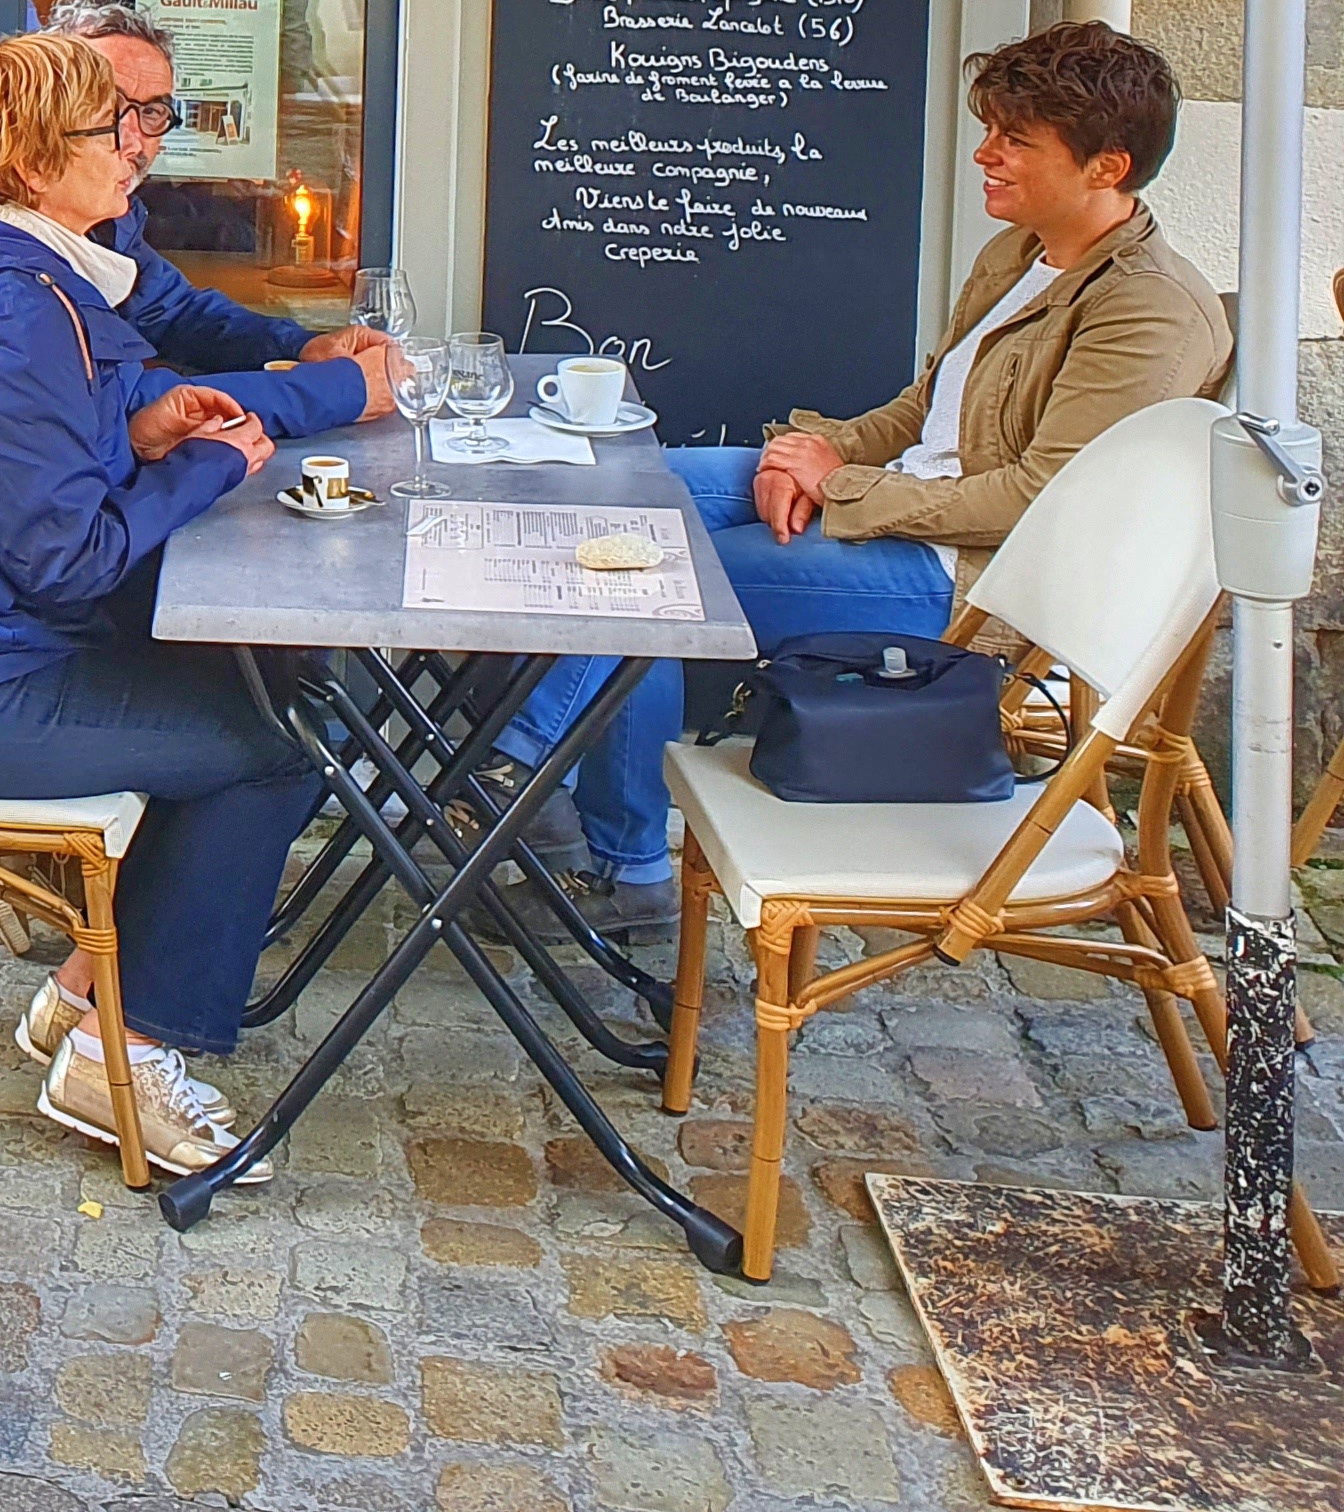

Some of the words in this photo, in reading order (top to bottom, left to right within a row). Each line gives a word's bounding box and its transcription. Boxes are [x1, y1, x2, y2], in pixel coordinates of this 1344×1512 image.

[603, 5, 694, 29] Brasserie
[702, 6, 784, 35] Lancelot
[798, 13, 854, 47] (56)
[610, 40, 703, 73] Kouigns
[708, 47, 830, 77] Bigoudens
[624, 70, 645, 85] de
[647, 70, 719, 92] froment
[798, 73, 823, 89] la
[641, 87, 666, 102] de
[533, 115, 579, 151] Les
[591, 130, 693, 153] meilleurs
[696, 137, 786, 167] produits,
[790, 132, 823, 160] la
[534, 154, 636, 176] meilleure
[575, 186, 644, 210] Viens
[647, 189, 670, 211] te
[675, 188, 736, 224] faire
[751, 198, 776, 216] de
[602, 217, 650, 235] dans
[660, 218, 714, 238] notre
[721, 220, 787, 251] jolie
[519, 287, 673, 370] Bon
